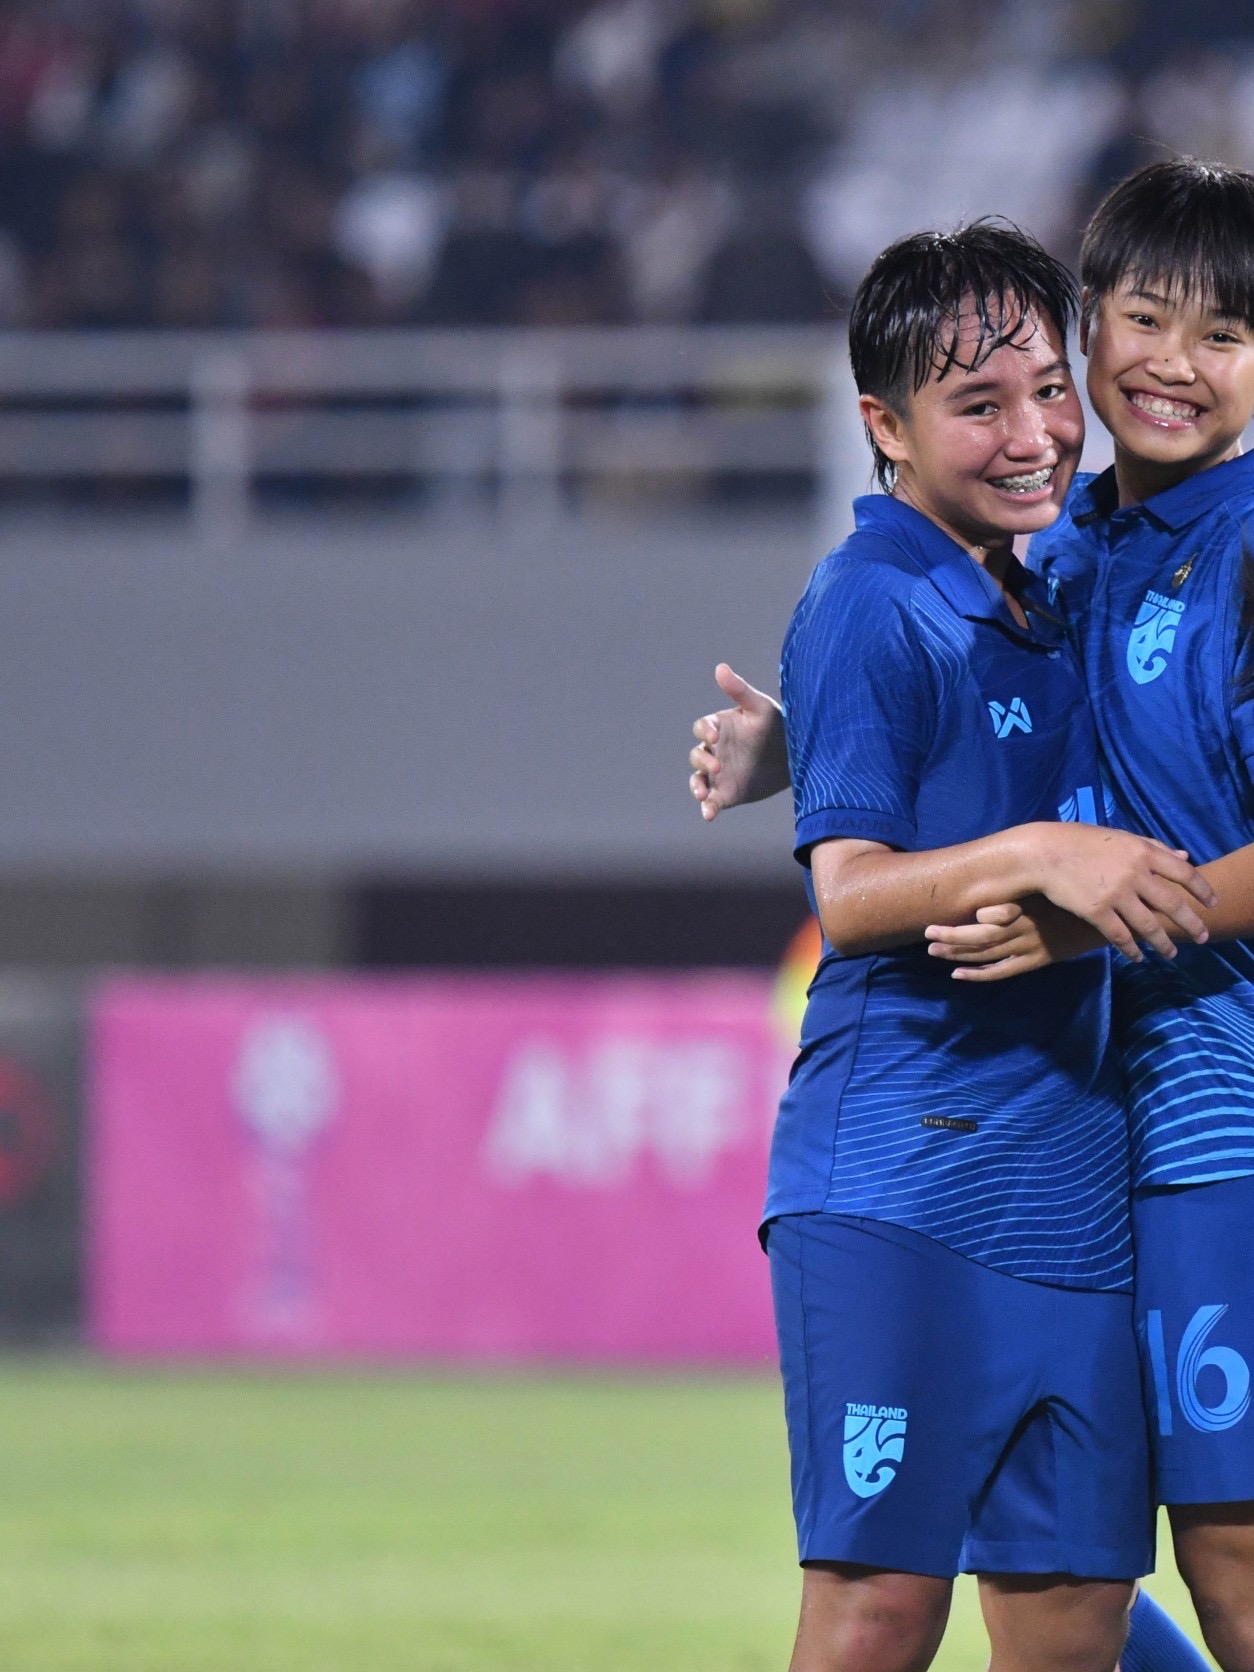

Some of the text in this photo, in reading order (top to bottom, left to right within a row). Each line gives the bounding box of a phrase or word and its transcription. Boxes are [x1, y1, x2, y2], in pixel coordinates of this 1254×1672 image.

[1145, 589, 1186, 613] THAILAND
[1143, 1303, 1250, 1436] 16
[846, 1402, 908, 1420] THAILAND
